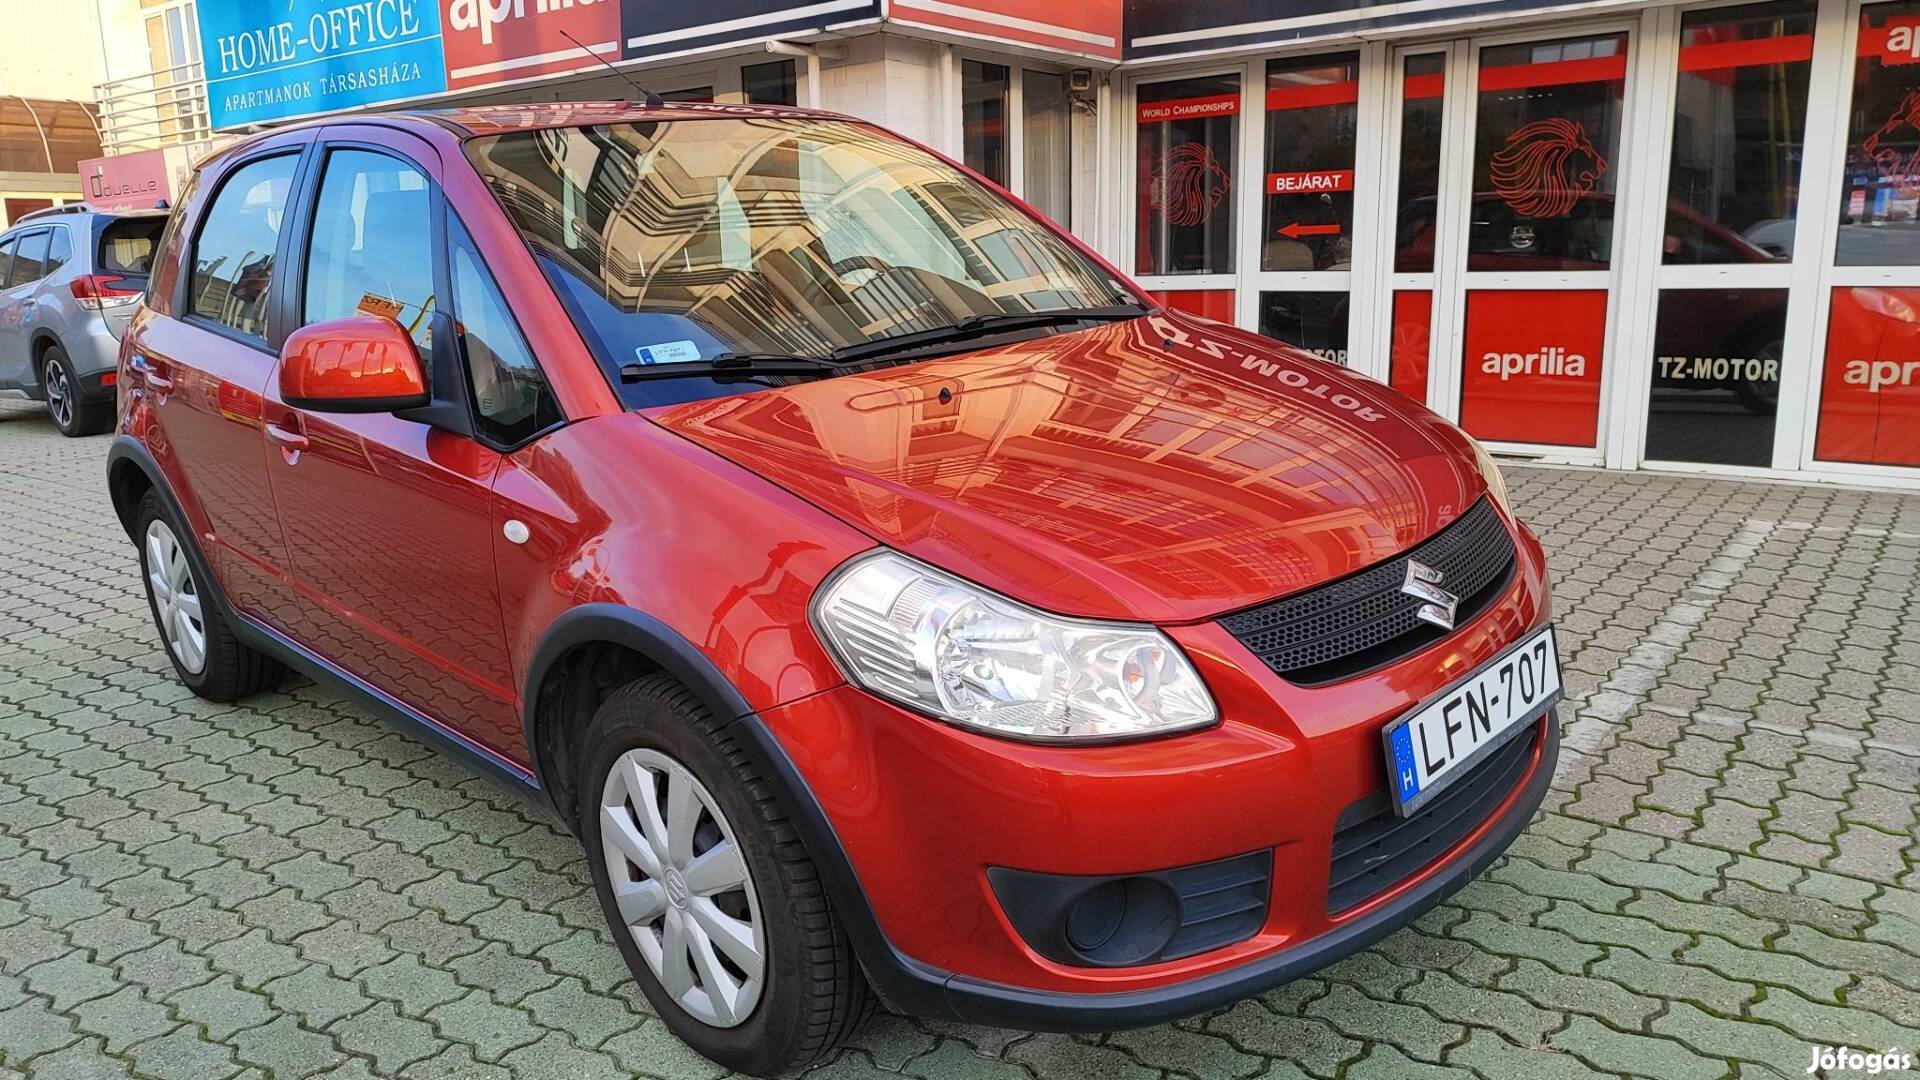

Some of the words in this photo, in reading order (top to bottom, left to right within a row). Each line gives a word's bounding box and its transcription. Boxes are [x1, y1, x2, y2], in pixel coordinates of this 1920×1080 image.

[217, 0, 420, 73] HOME-OFFICE
[225, 81, 312, 112] APARTMANOK
[320, 62, 421, 95] TÁRSASHÁZA
[1276, 173, 1342, 191] BEJÁRAT
[1481, 347, 1585, 381] aprilia
[1657, 356, 1779, 382] TZ-MOTOR
[1419, 639, 1547, 778] LFN-707
[1402, 768, 1414, 791] H
